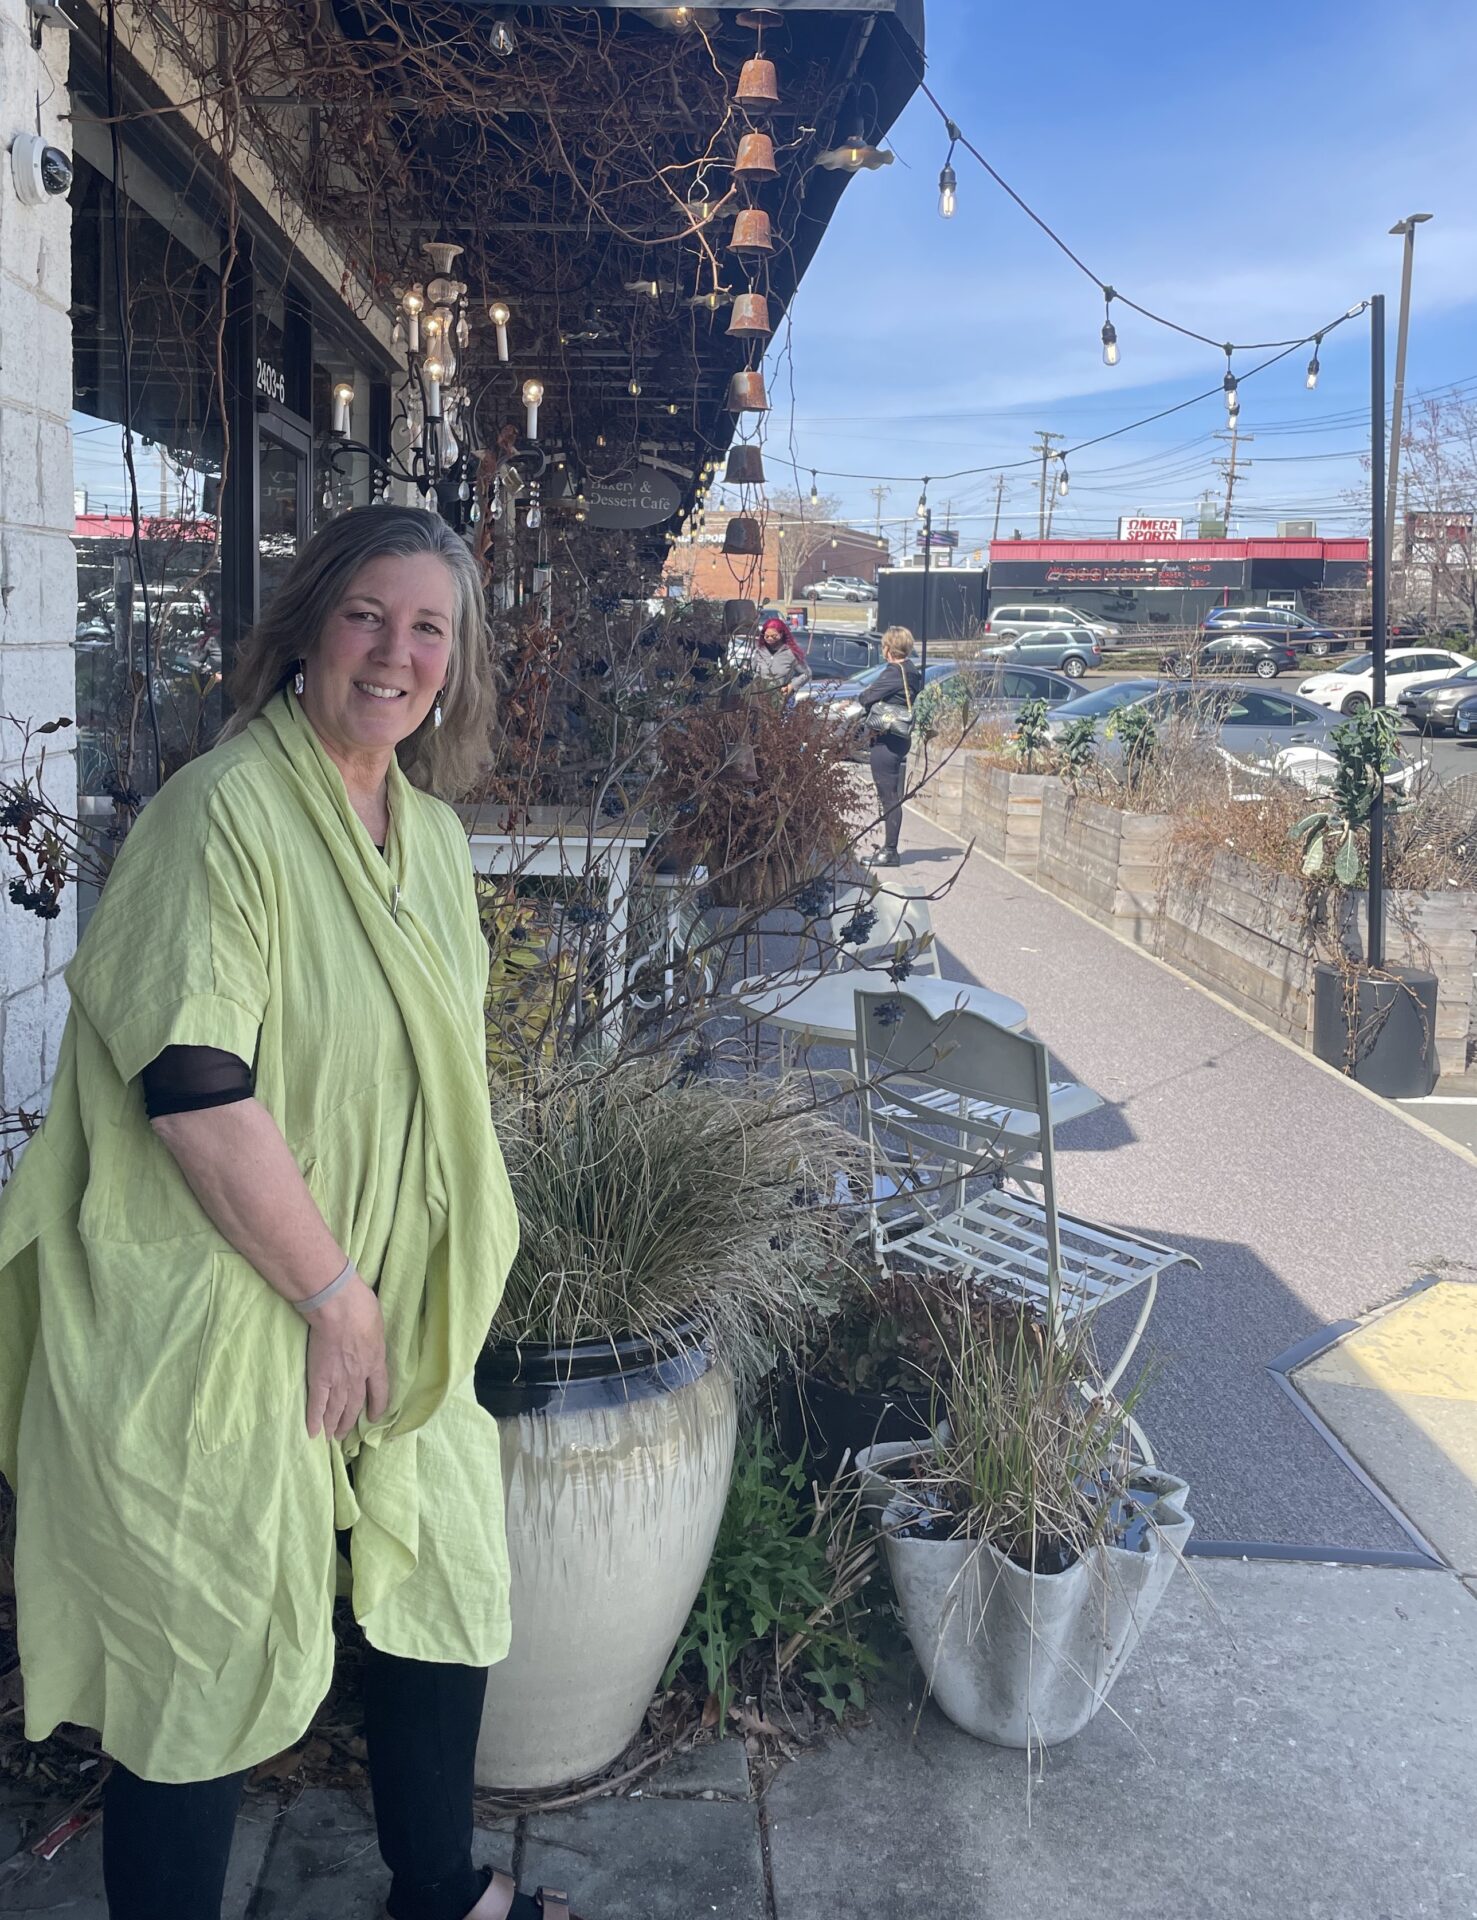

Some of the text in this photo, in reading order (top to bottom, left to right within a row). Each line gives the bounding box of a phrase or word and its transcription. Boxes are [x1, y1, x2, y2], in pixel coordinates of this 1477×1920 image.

[256, 357, 285, 404] 2403-6
[640, 481, 652, 494] &
[590, 492, 671, 511] Dessert Café
[697, 533, 726, 543] SPOR
[1127, 531, 1177, 541] SPORTS
